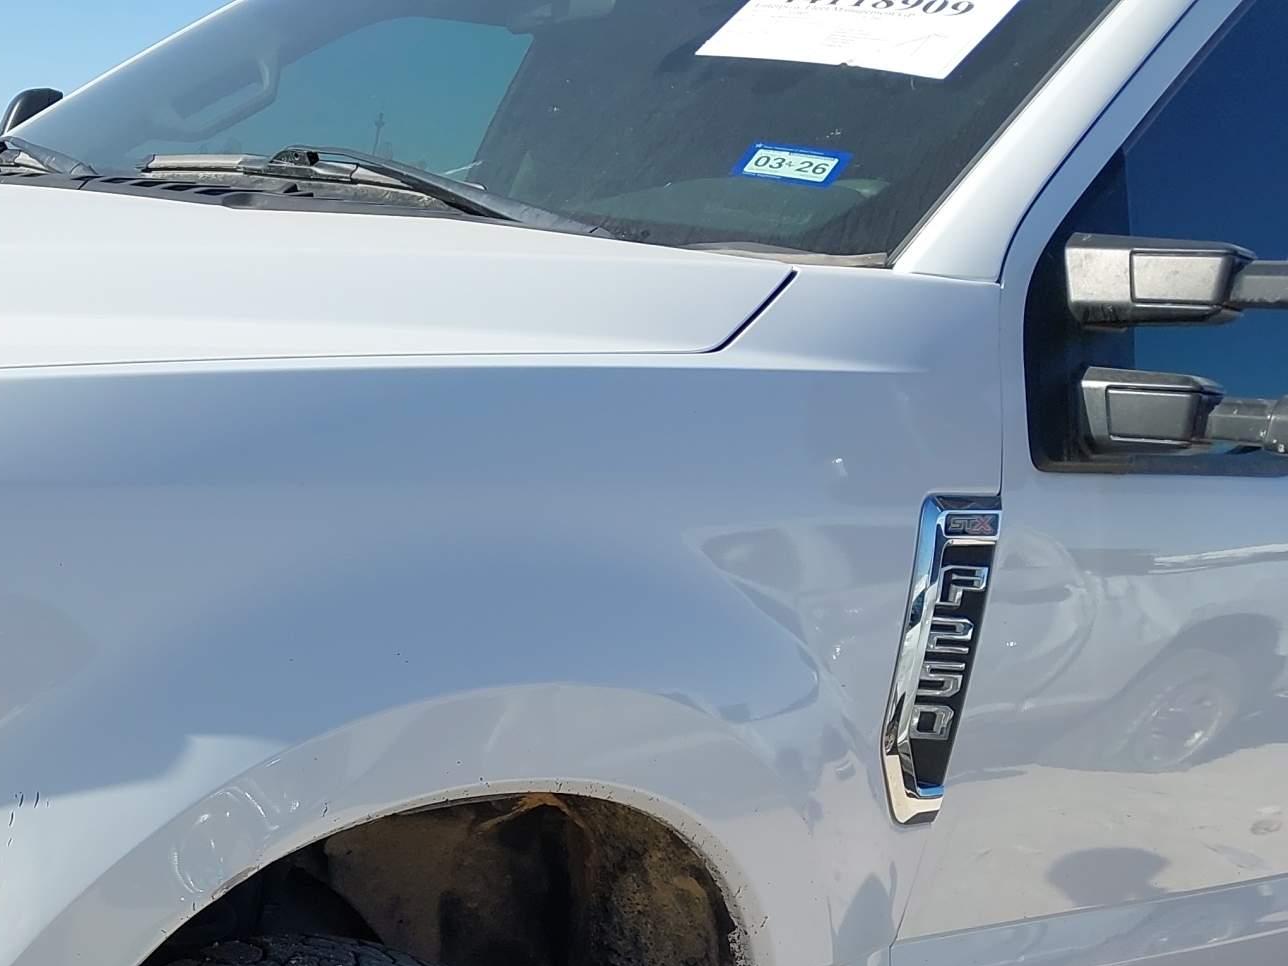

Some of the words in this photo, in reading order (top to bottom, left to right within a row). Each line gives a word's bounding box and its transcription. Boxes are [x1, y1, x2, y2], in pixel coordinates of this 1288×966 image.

[753, 155, 786, 169] 03
[794, 160, 830, 175] 26
[948, 516, 993, 534] STX
